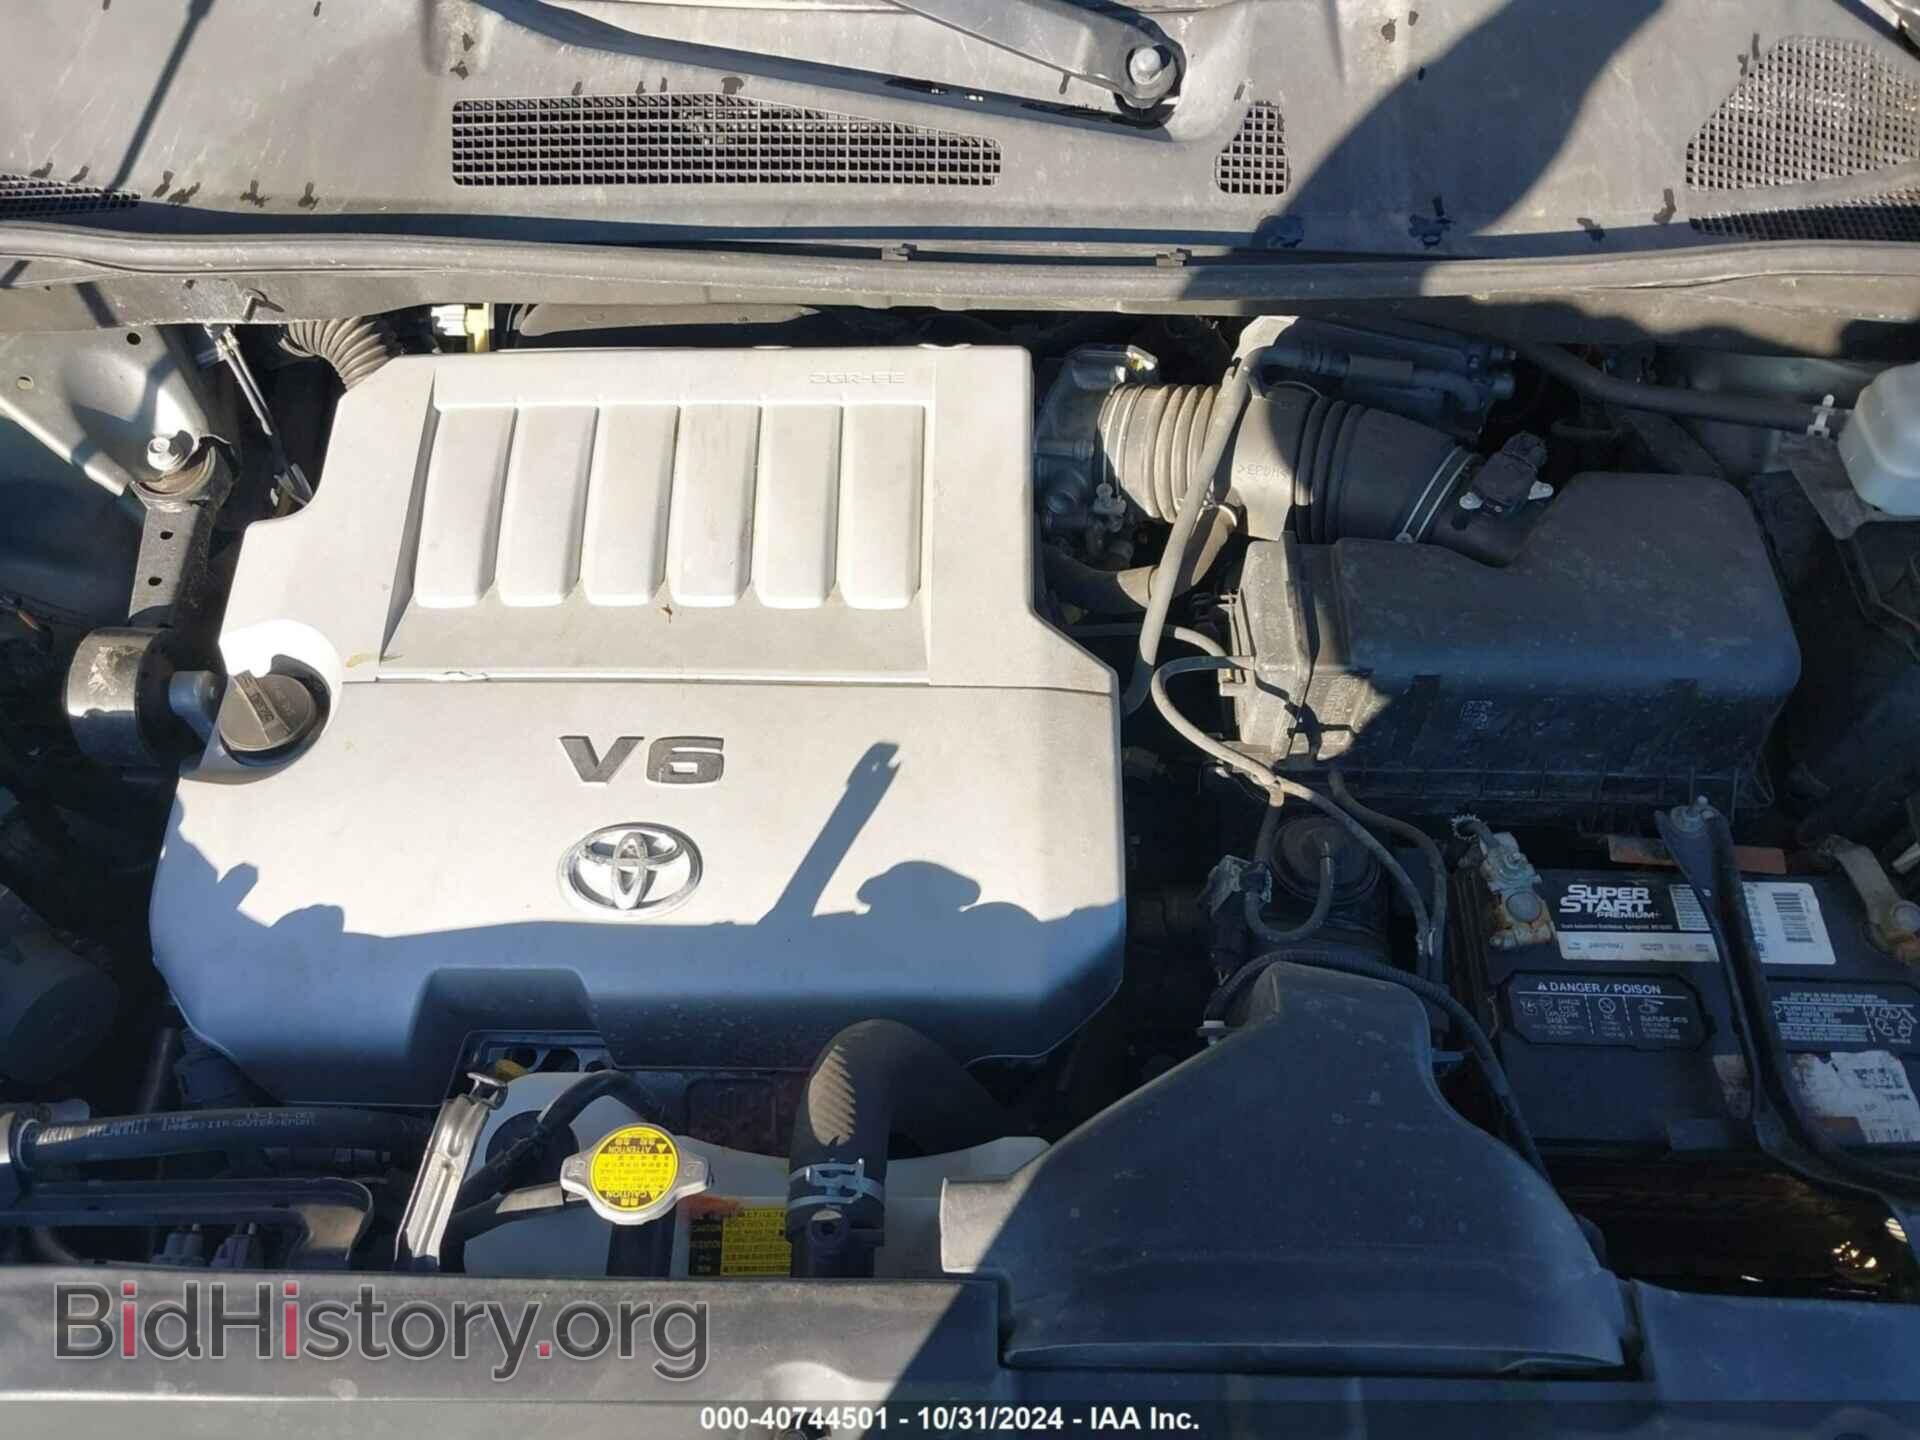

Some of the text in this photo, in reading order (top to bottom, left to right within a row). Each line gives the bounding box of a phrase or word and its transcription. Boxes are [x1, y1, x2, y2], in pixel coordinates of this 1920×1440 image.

[558, 735, 725, 785] V6
[1567, 884, 1649, 900] SUPER
[1559, 897, 1653, 914] START
[1550, 982, 1600, 993] DANGER
[1614, 984, 1662, 994] POISON
[608, 1145, 651, 1154] ATTENTION
[606, 1190, 648, 1199] CAUTION
